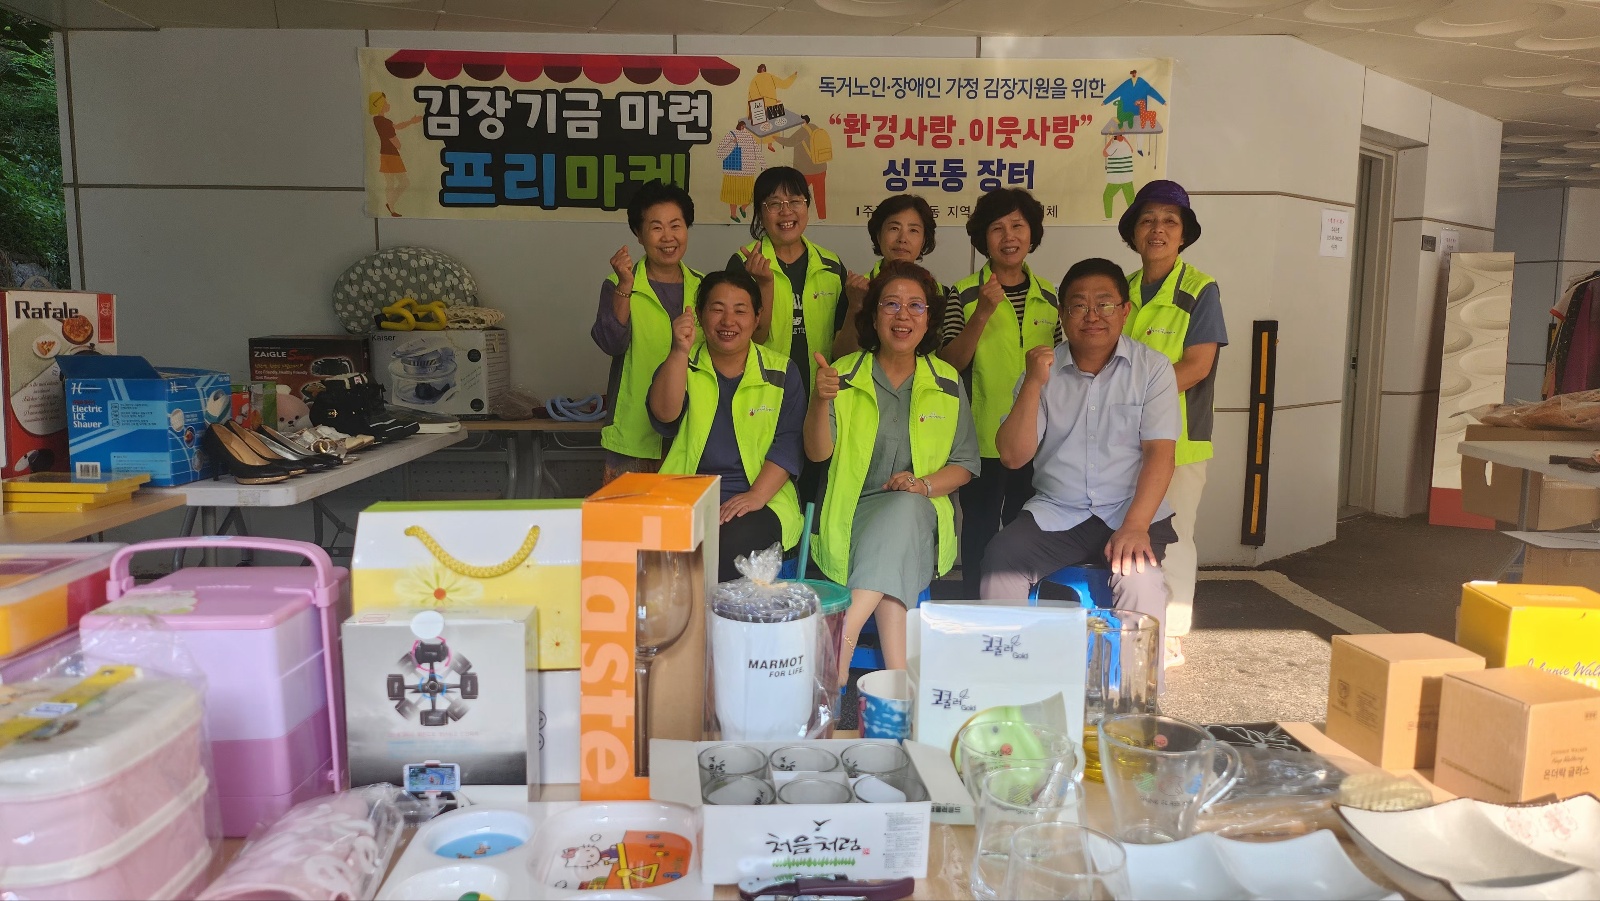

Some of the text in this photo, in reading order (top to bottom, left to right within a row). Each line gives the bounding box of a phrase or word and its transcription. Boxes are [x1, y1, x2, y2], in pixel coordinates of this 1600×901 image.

[945, 77, 979, 99] 가정
[983, 77, 1068, 100] 김장지원을
[1070, 77, 1106, 99] 위한
[417, 88, 710, 141] 김장기금 마련
[882, 157, 1035, 192] 성포동 장터
[15, 300, 79, 319] Rafale
[71, 404, 103, 413] Electric
[73, 412, 86, 420] ICE
[748, 655, 804, 669] MARMOT
[1012, 651, 1029, 659] Gold
[769, 670, 785, 678] FOR
[1568, 765, 1590, 778] 글라스
[765, 833, 862, 855] 처음처럼
